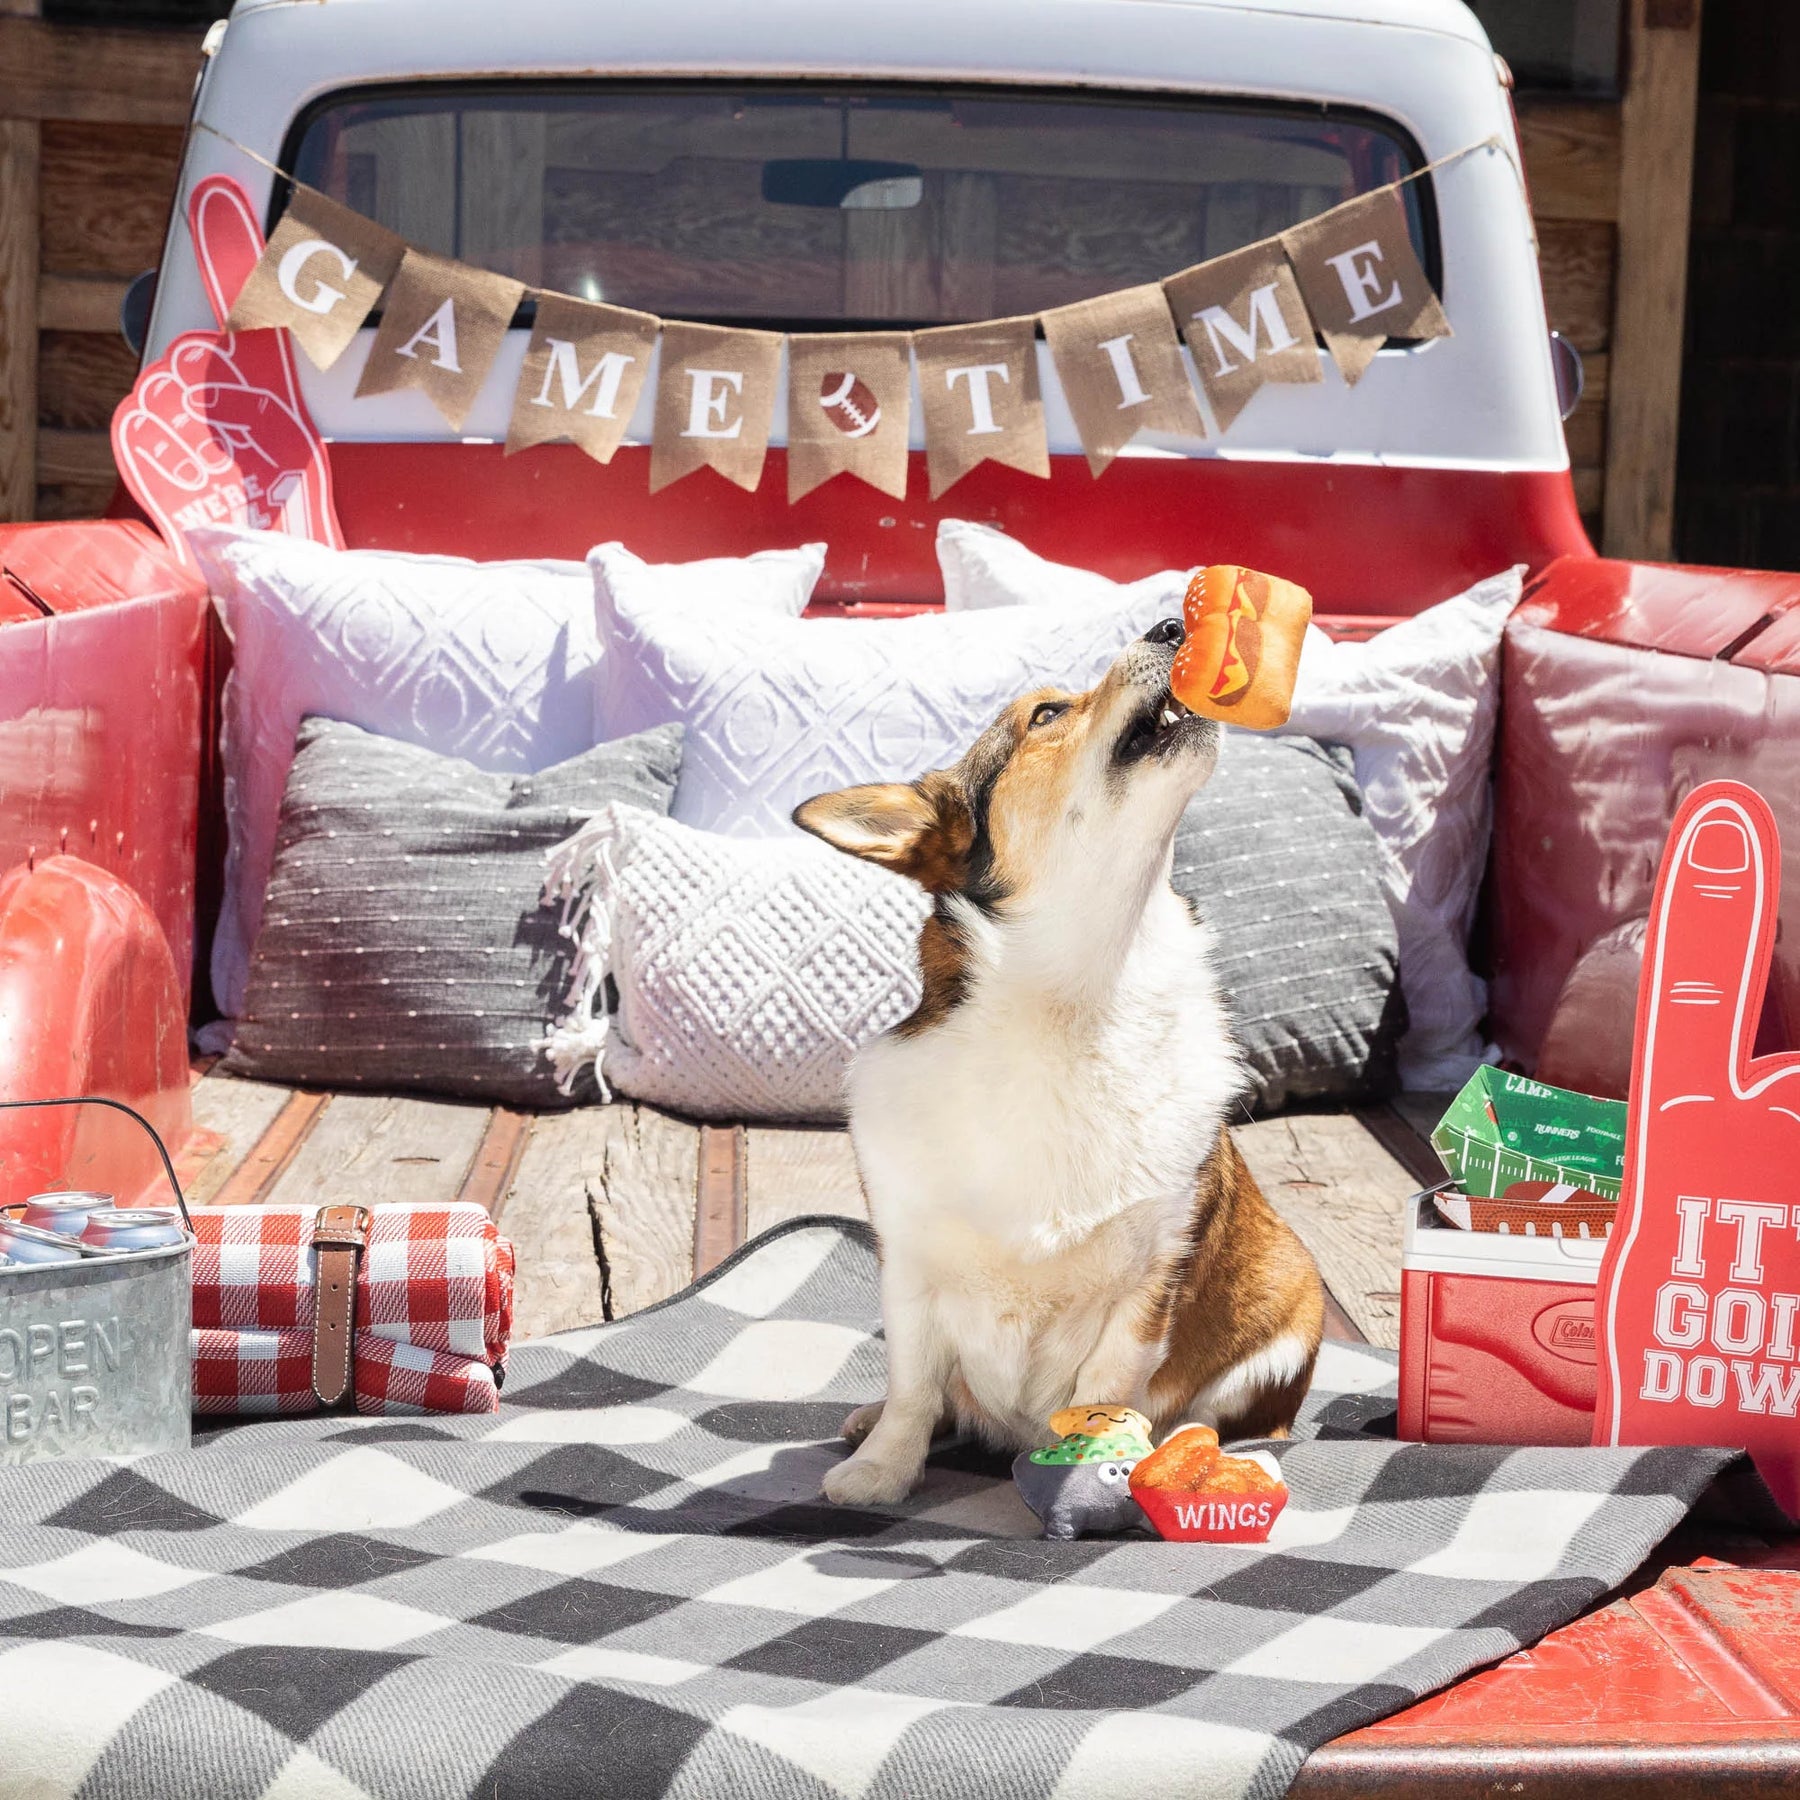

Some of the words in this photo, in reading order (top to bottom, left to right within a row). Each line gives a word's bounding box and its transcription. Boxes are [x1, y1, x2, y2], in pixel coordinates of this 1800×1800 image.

[1534, 1123, 1581, 1140] RUNNERS
[0, 1316, 120, 1386] OPEN
[6, 1385, 100, 1445] BAR
[1174, 1502, 1273, 1530] WINGS
